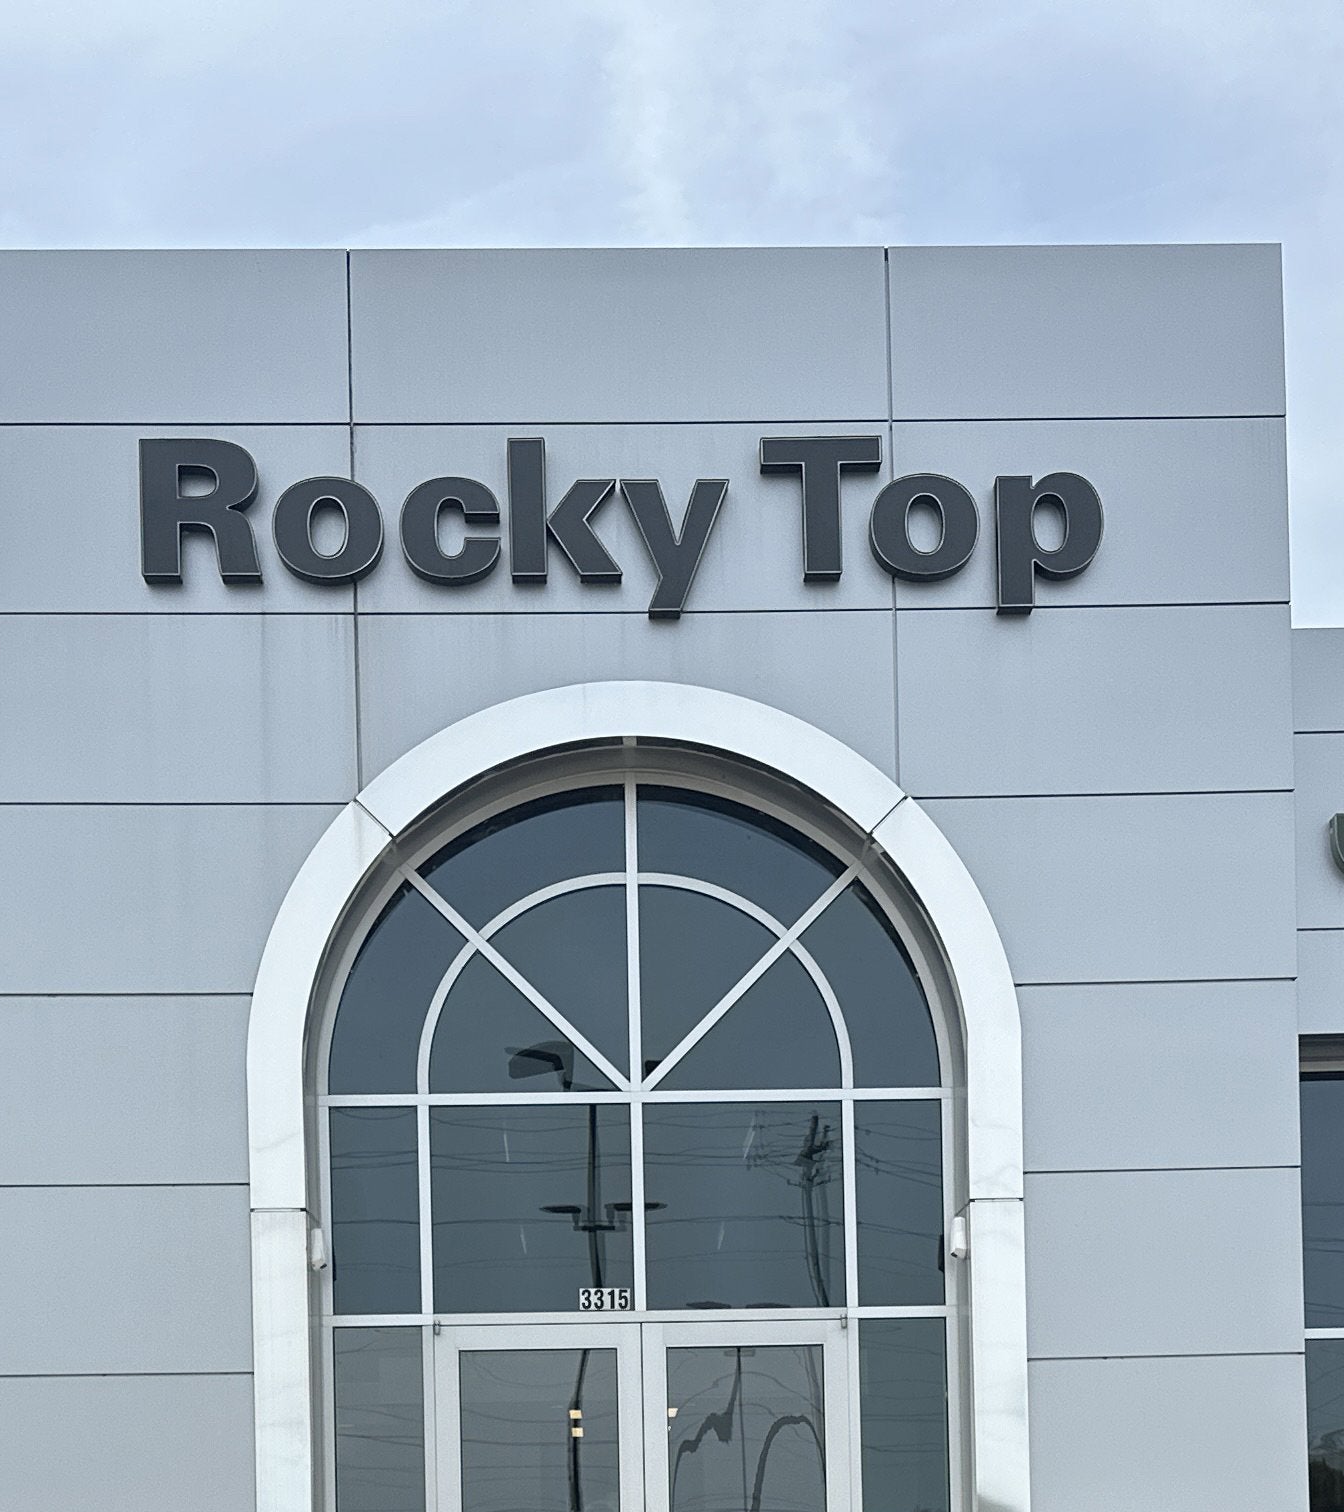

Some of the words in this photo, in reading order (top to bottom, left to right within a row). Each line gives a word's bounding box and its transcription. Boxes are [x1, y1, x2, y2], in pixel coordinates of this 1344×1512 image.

[138, 436, 730, 620] Rocky
[759, 435, 1105, 615] Top
[581, 1289, 629, 1310] 3315
